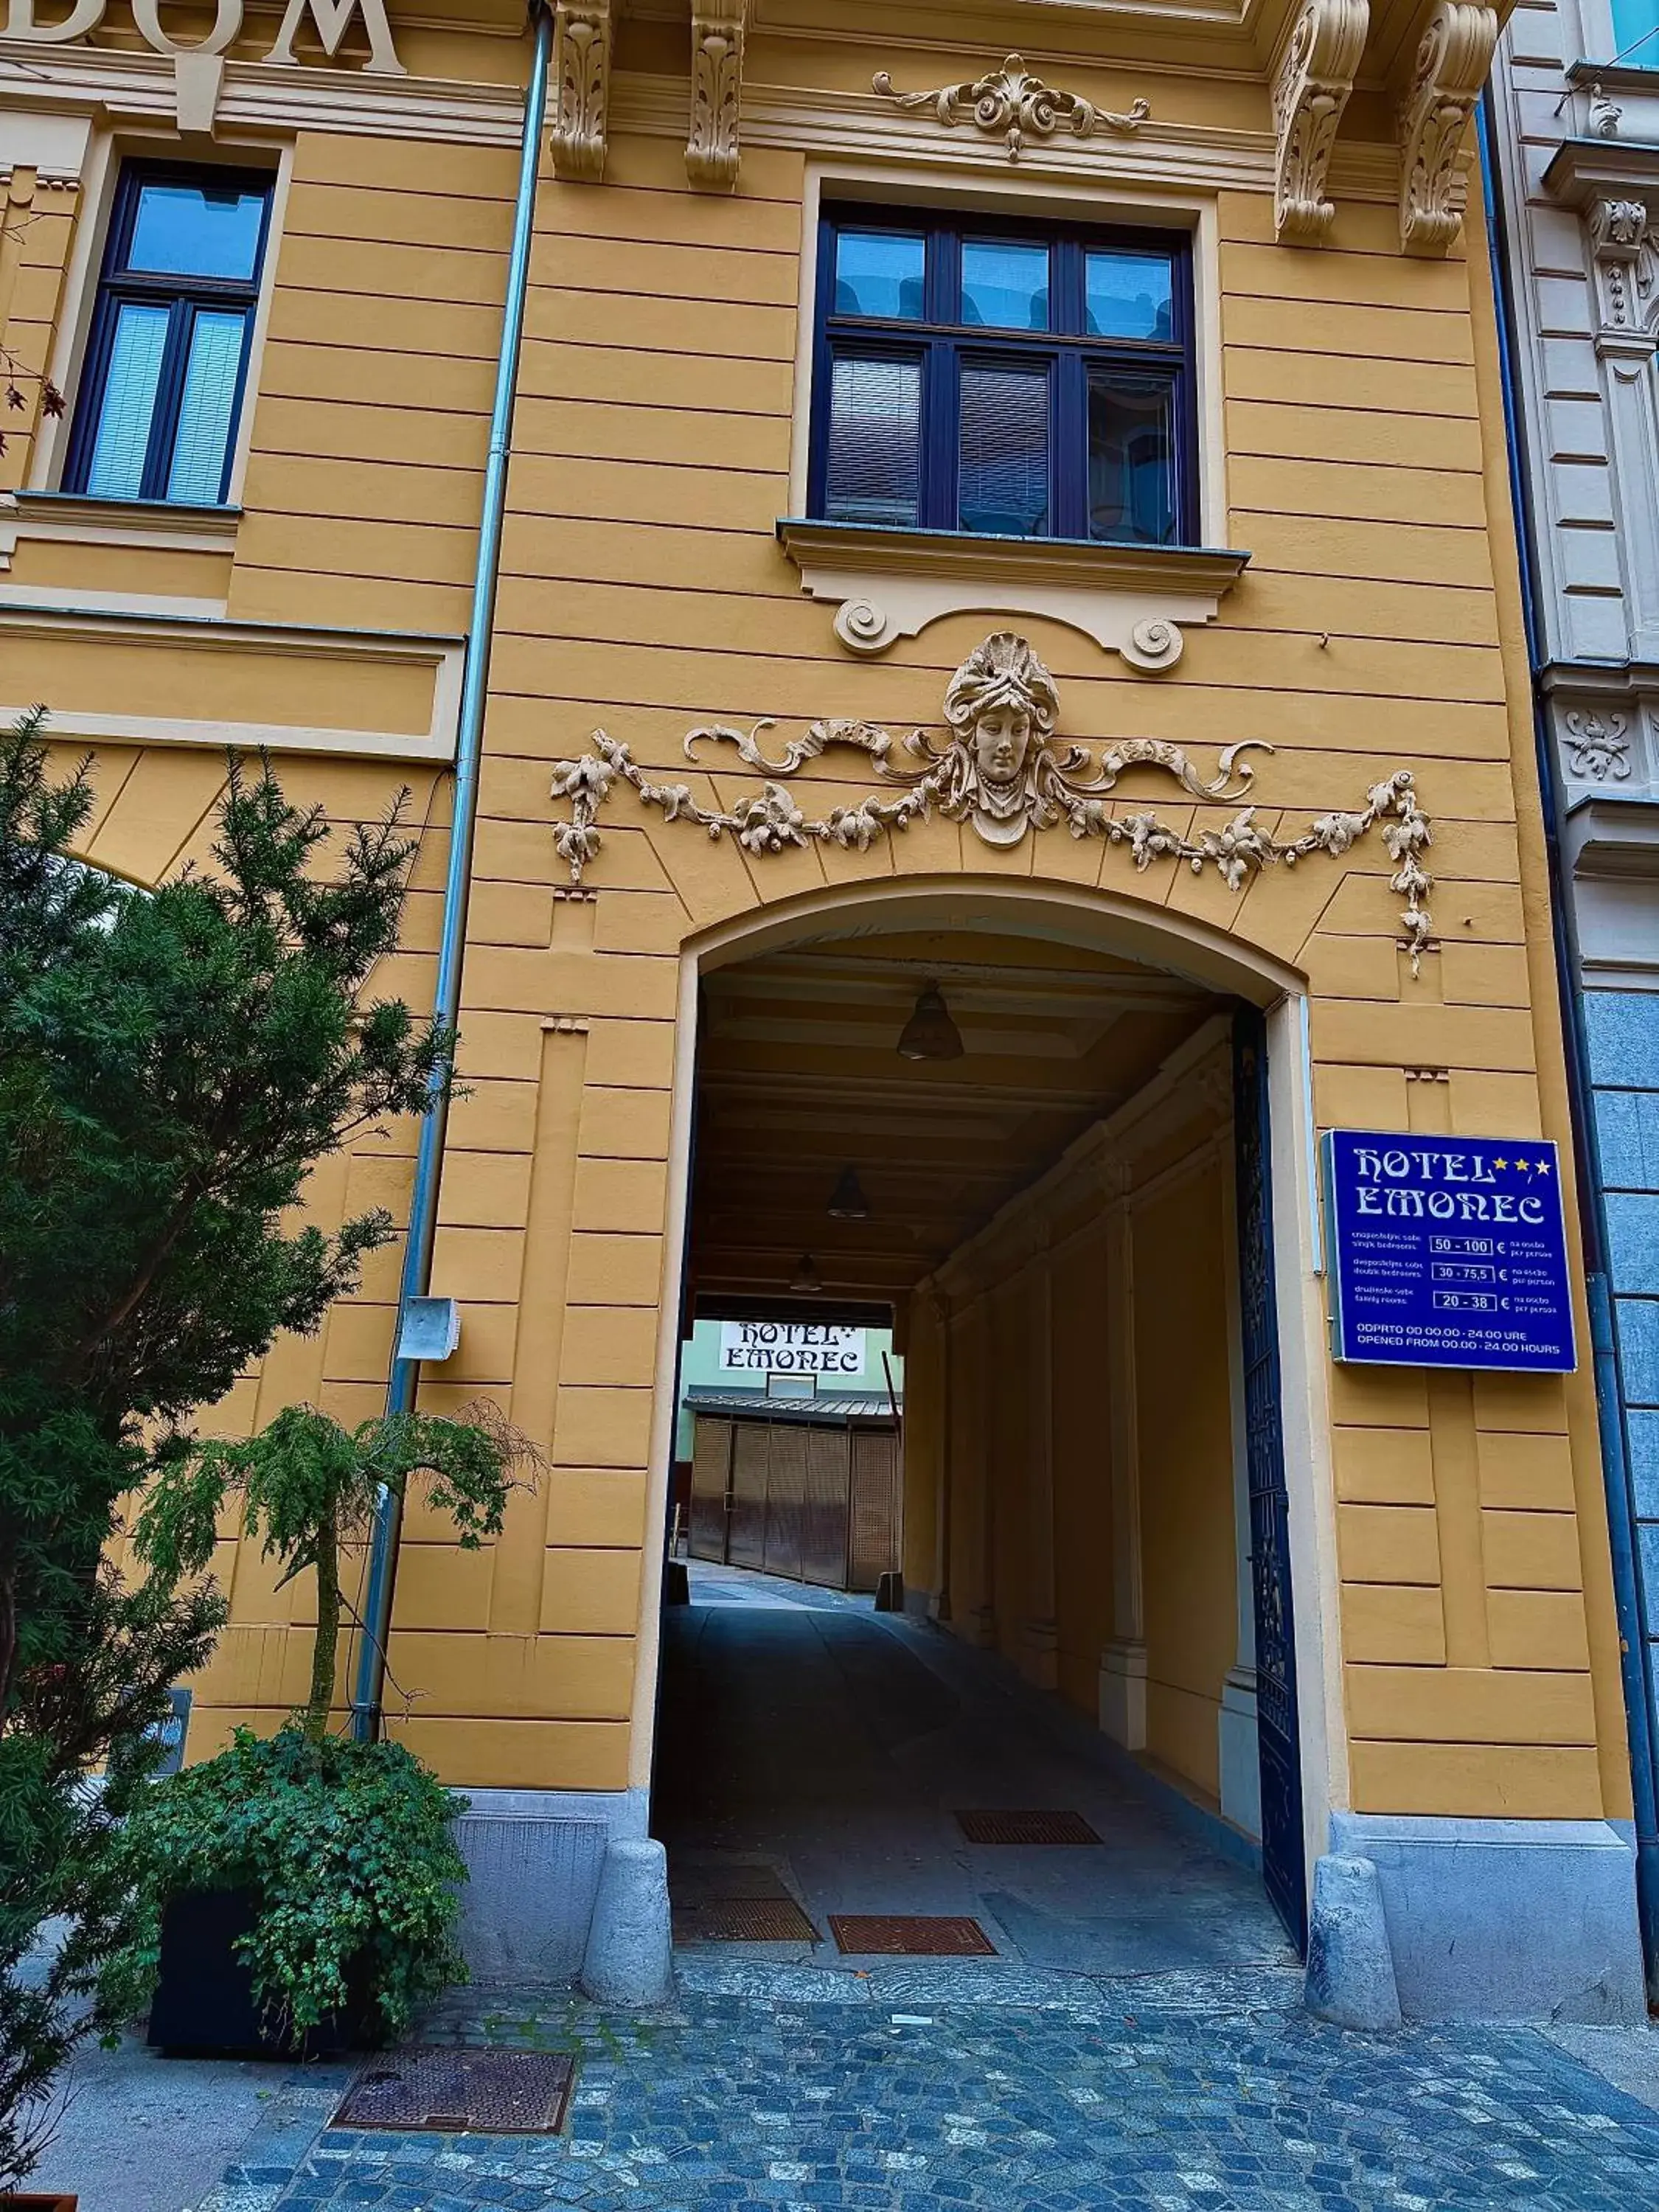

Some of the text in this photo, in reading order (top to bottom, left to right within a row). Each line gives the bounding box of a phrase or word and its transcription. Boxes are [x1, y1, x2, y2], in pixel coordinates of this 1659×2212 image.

[1353, 1148, 1496, 1183] HOTEL
[1355, 1186, 1544, 1224] EMONEC
[1436, 1238, 1451, 1251] 50
[1464, 1240, 1487, 1253] 100
[1439, 1267, 1453, 1278] 30
[1464, 1268, 1487, 1281] 75,5
[1443, 1295, 1459, 1307] 20
[1471, 1296, 1487, 1309] 38
[739, 1324, 840, 1348] HOTEL
[1357, 1323, 1403, 1334] ODPRTO
[1406, 1326, 1422, 1335] OD
[1425, 1327, 1460, 1337] 00.00
[1467, 1329, 1502, 1340] 24.00
[1504, 1332, 1527, 1341] URE
[1357, 1335, 1403, 1346] OPENED
[1406, 1338, 1439, 1347] FROM
[1441, 1340, 1477, 1350] 00.00
[1484, 1342, 1518, 1352] 24.00
[1521, 1344, 1561, 1354] HOURS
[726, 1348, 858, 1372] EMONEC
